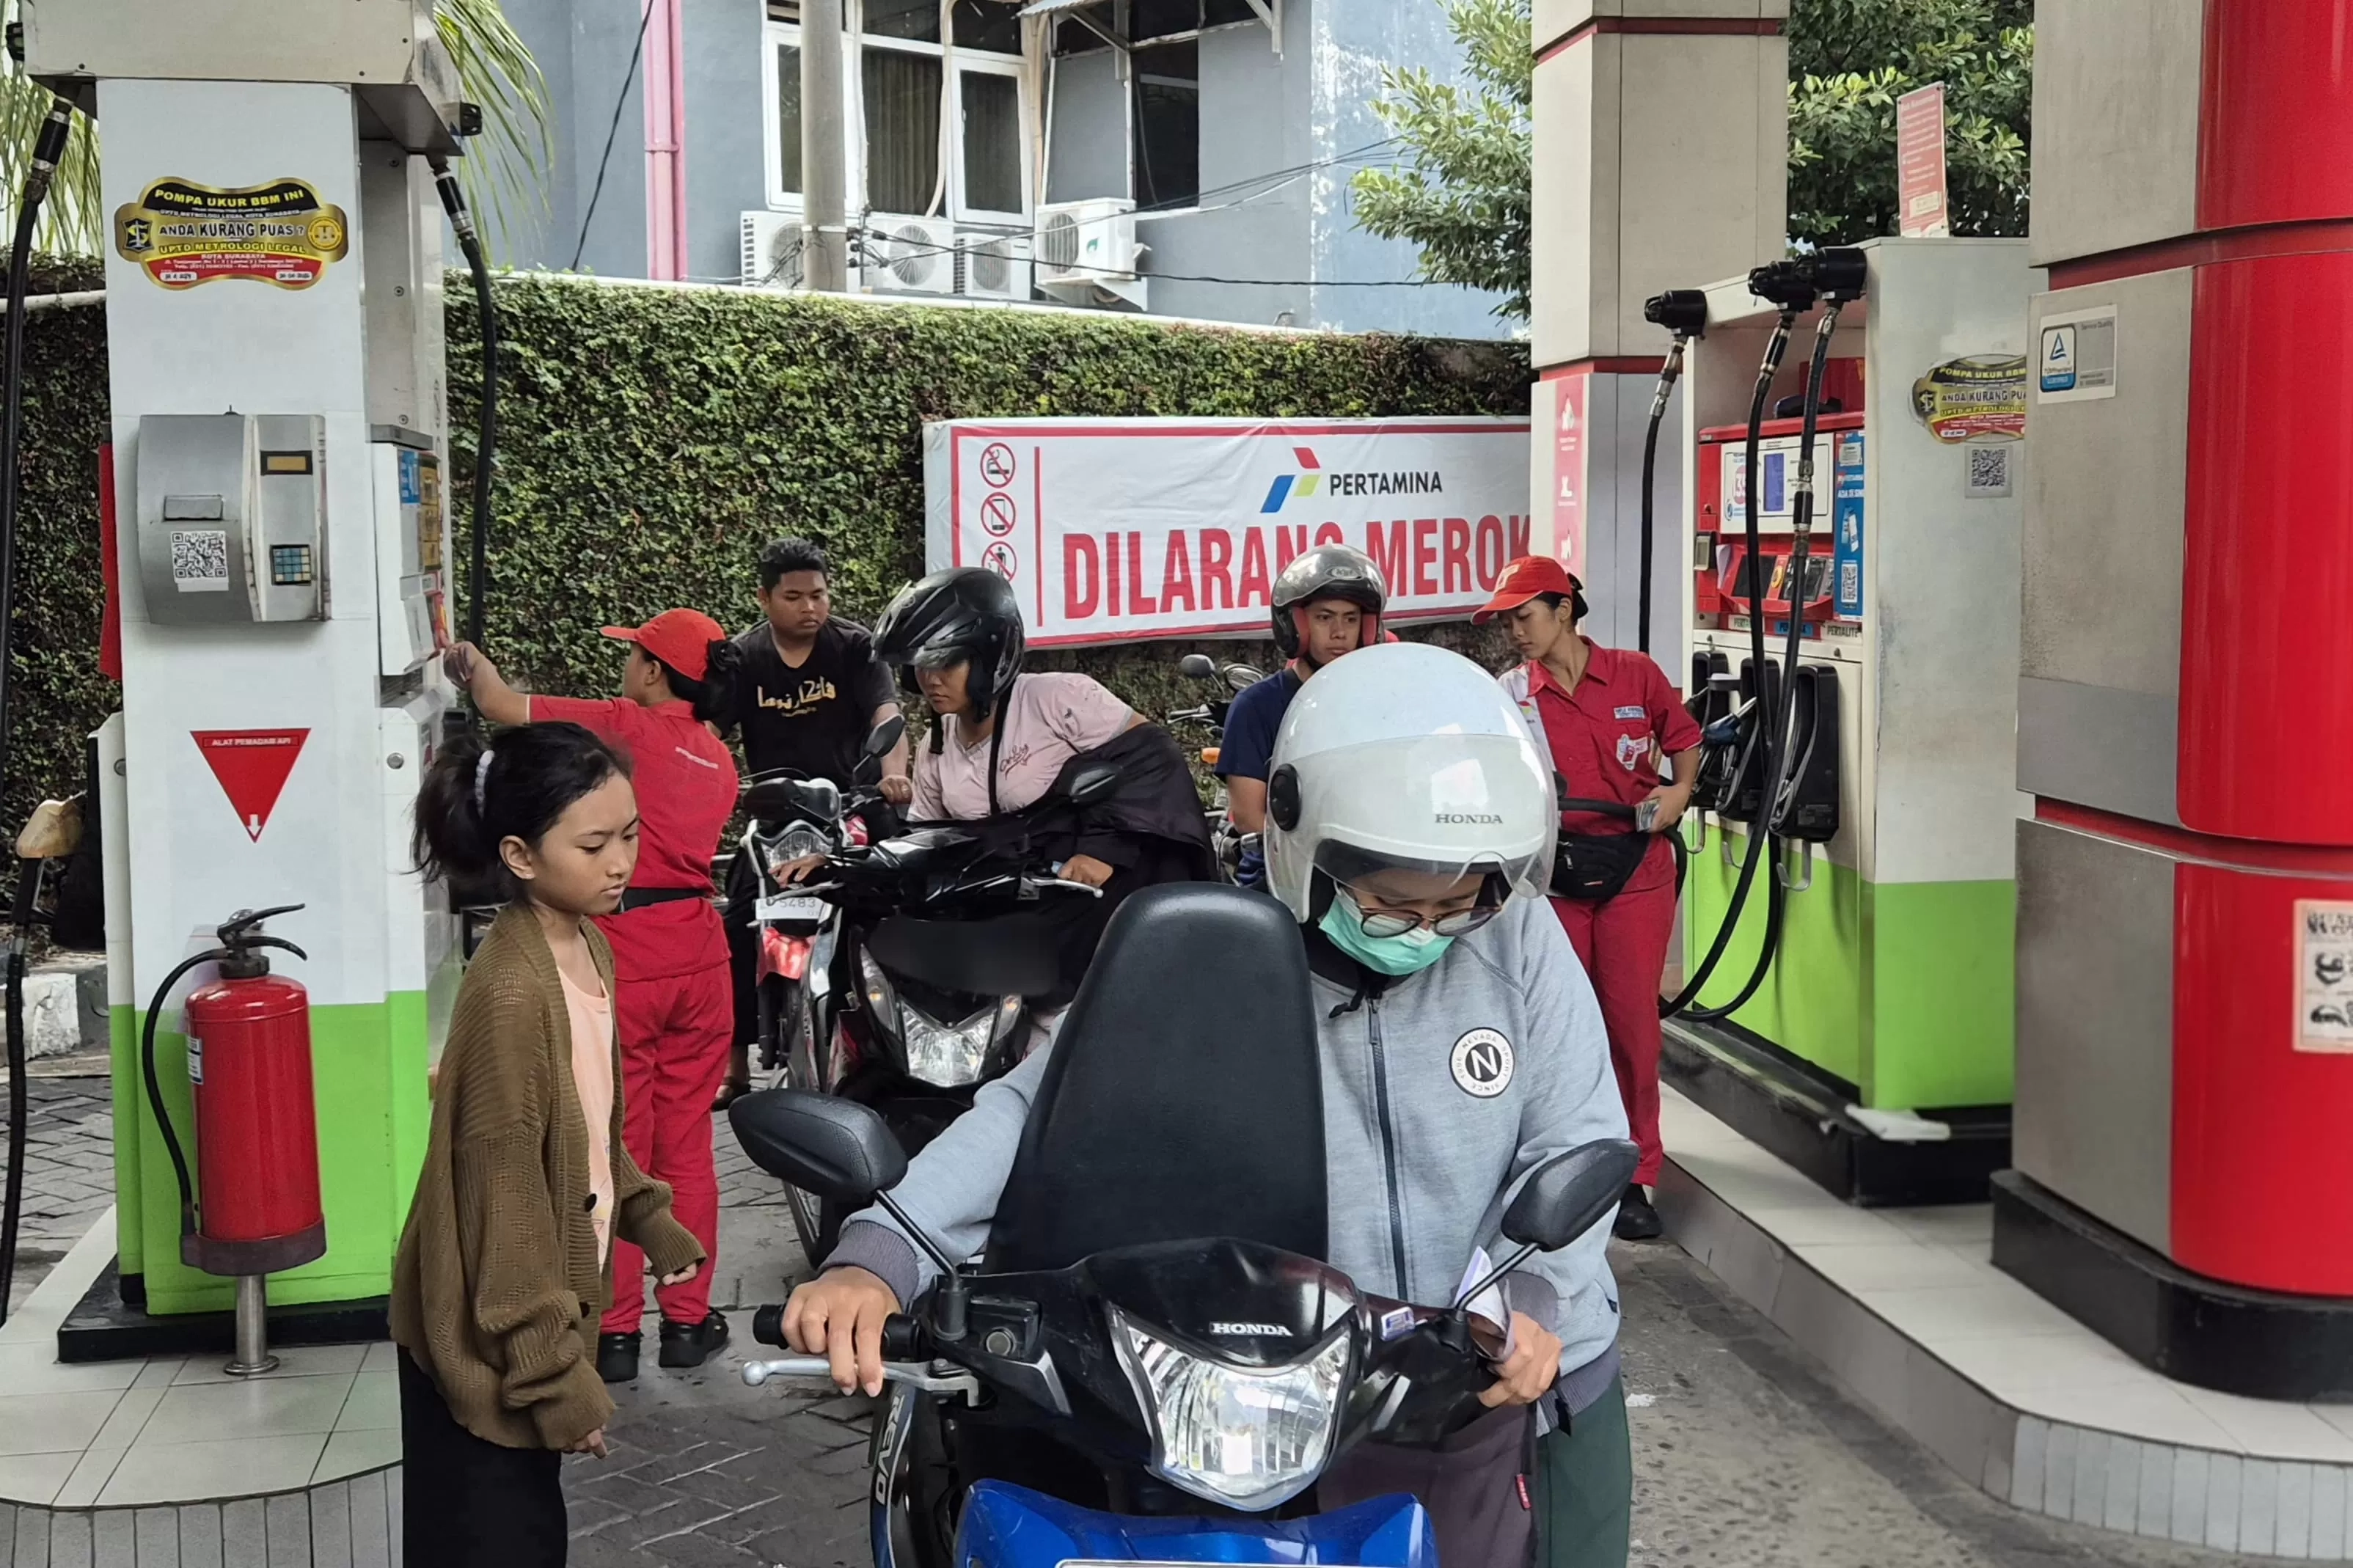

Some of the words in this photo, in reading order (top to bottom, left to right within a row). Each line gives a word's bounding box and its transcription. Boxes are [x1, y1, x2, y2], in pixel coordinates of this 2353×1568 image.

[155, 189, 202, 205] POMPA
[207, 197, 247, 207] UKUR
[250, 194, 280, 206] BBM
[284, 189, 304, 202] INI
[159, 224, 195, 235] ANDA
[200, 223, 255, 236] KURANG
[260, 223, 293, 236] PUAS
[159, 245, 191, 254] UPTD
[195, 242, 264, 251] METROLOGI
[268, 243, 305, 254] LEGAL
[1939, 367, 1972, 378] POMPA
[1942, 393, 1966, 401] ANDA
[1969, 390, 2008, 402] KURANG
[1330, 471, 1443, 497] PERTAMINA
[1826, 625, 1858, 637] PERTALITE
[1434, 813, 1504, 824] HONDA
[1471, 1045, 1498, 1080] N
[1211, 1322, 1294, 1337] HONDA
[876, 1395, 902, 1506] REVO
